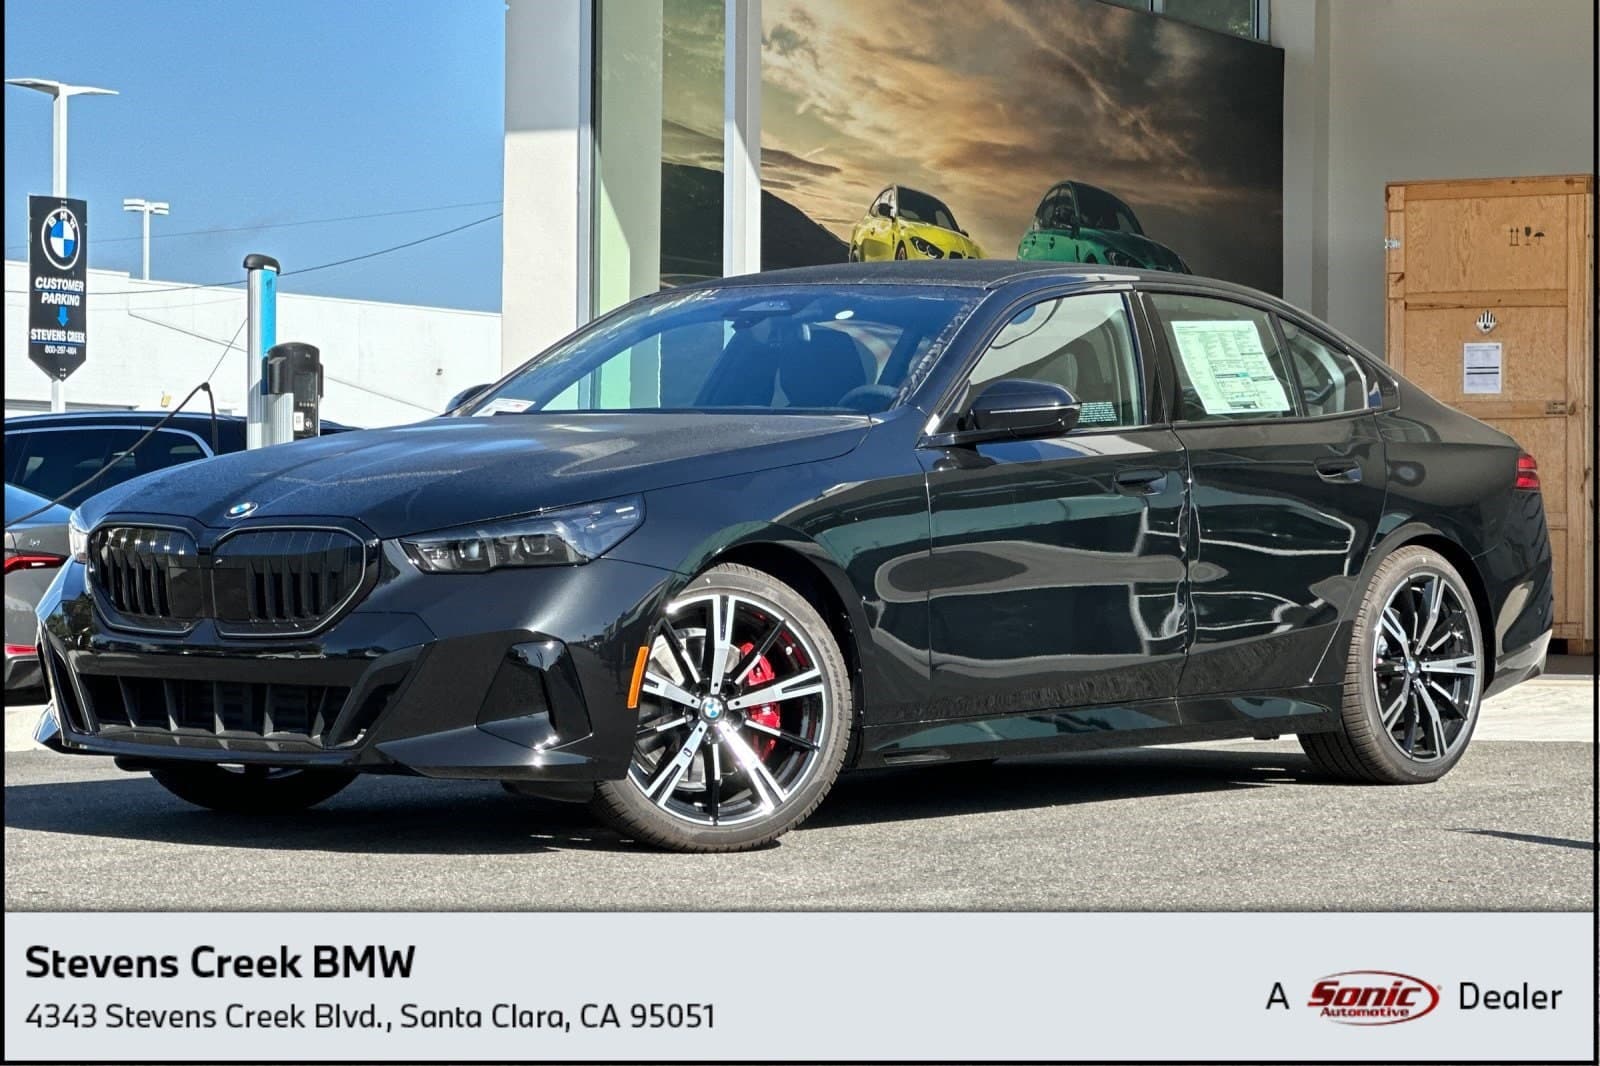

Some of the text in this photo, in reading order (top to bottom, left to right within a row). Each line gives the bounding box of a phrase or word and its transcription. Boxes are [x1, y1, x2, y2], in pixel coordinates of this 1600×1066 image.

[35, 277, 84, 292] CUSTOMER
[41, 292, 80, 306] PARKING
[30, 328, 86, 343] STEVENS CREEK
